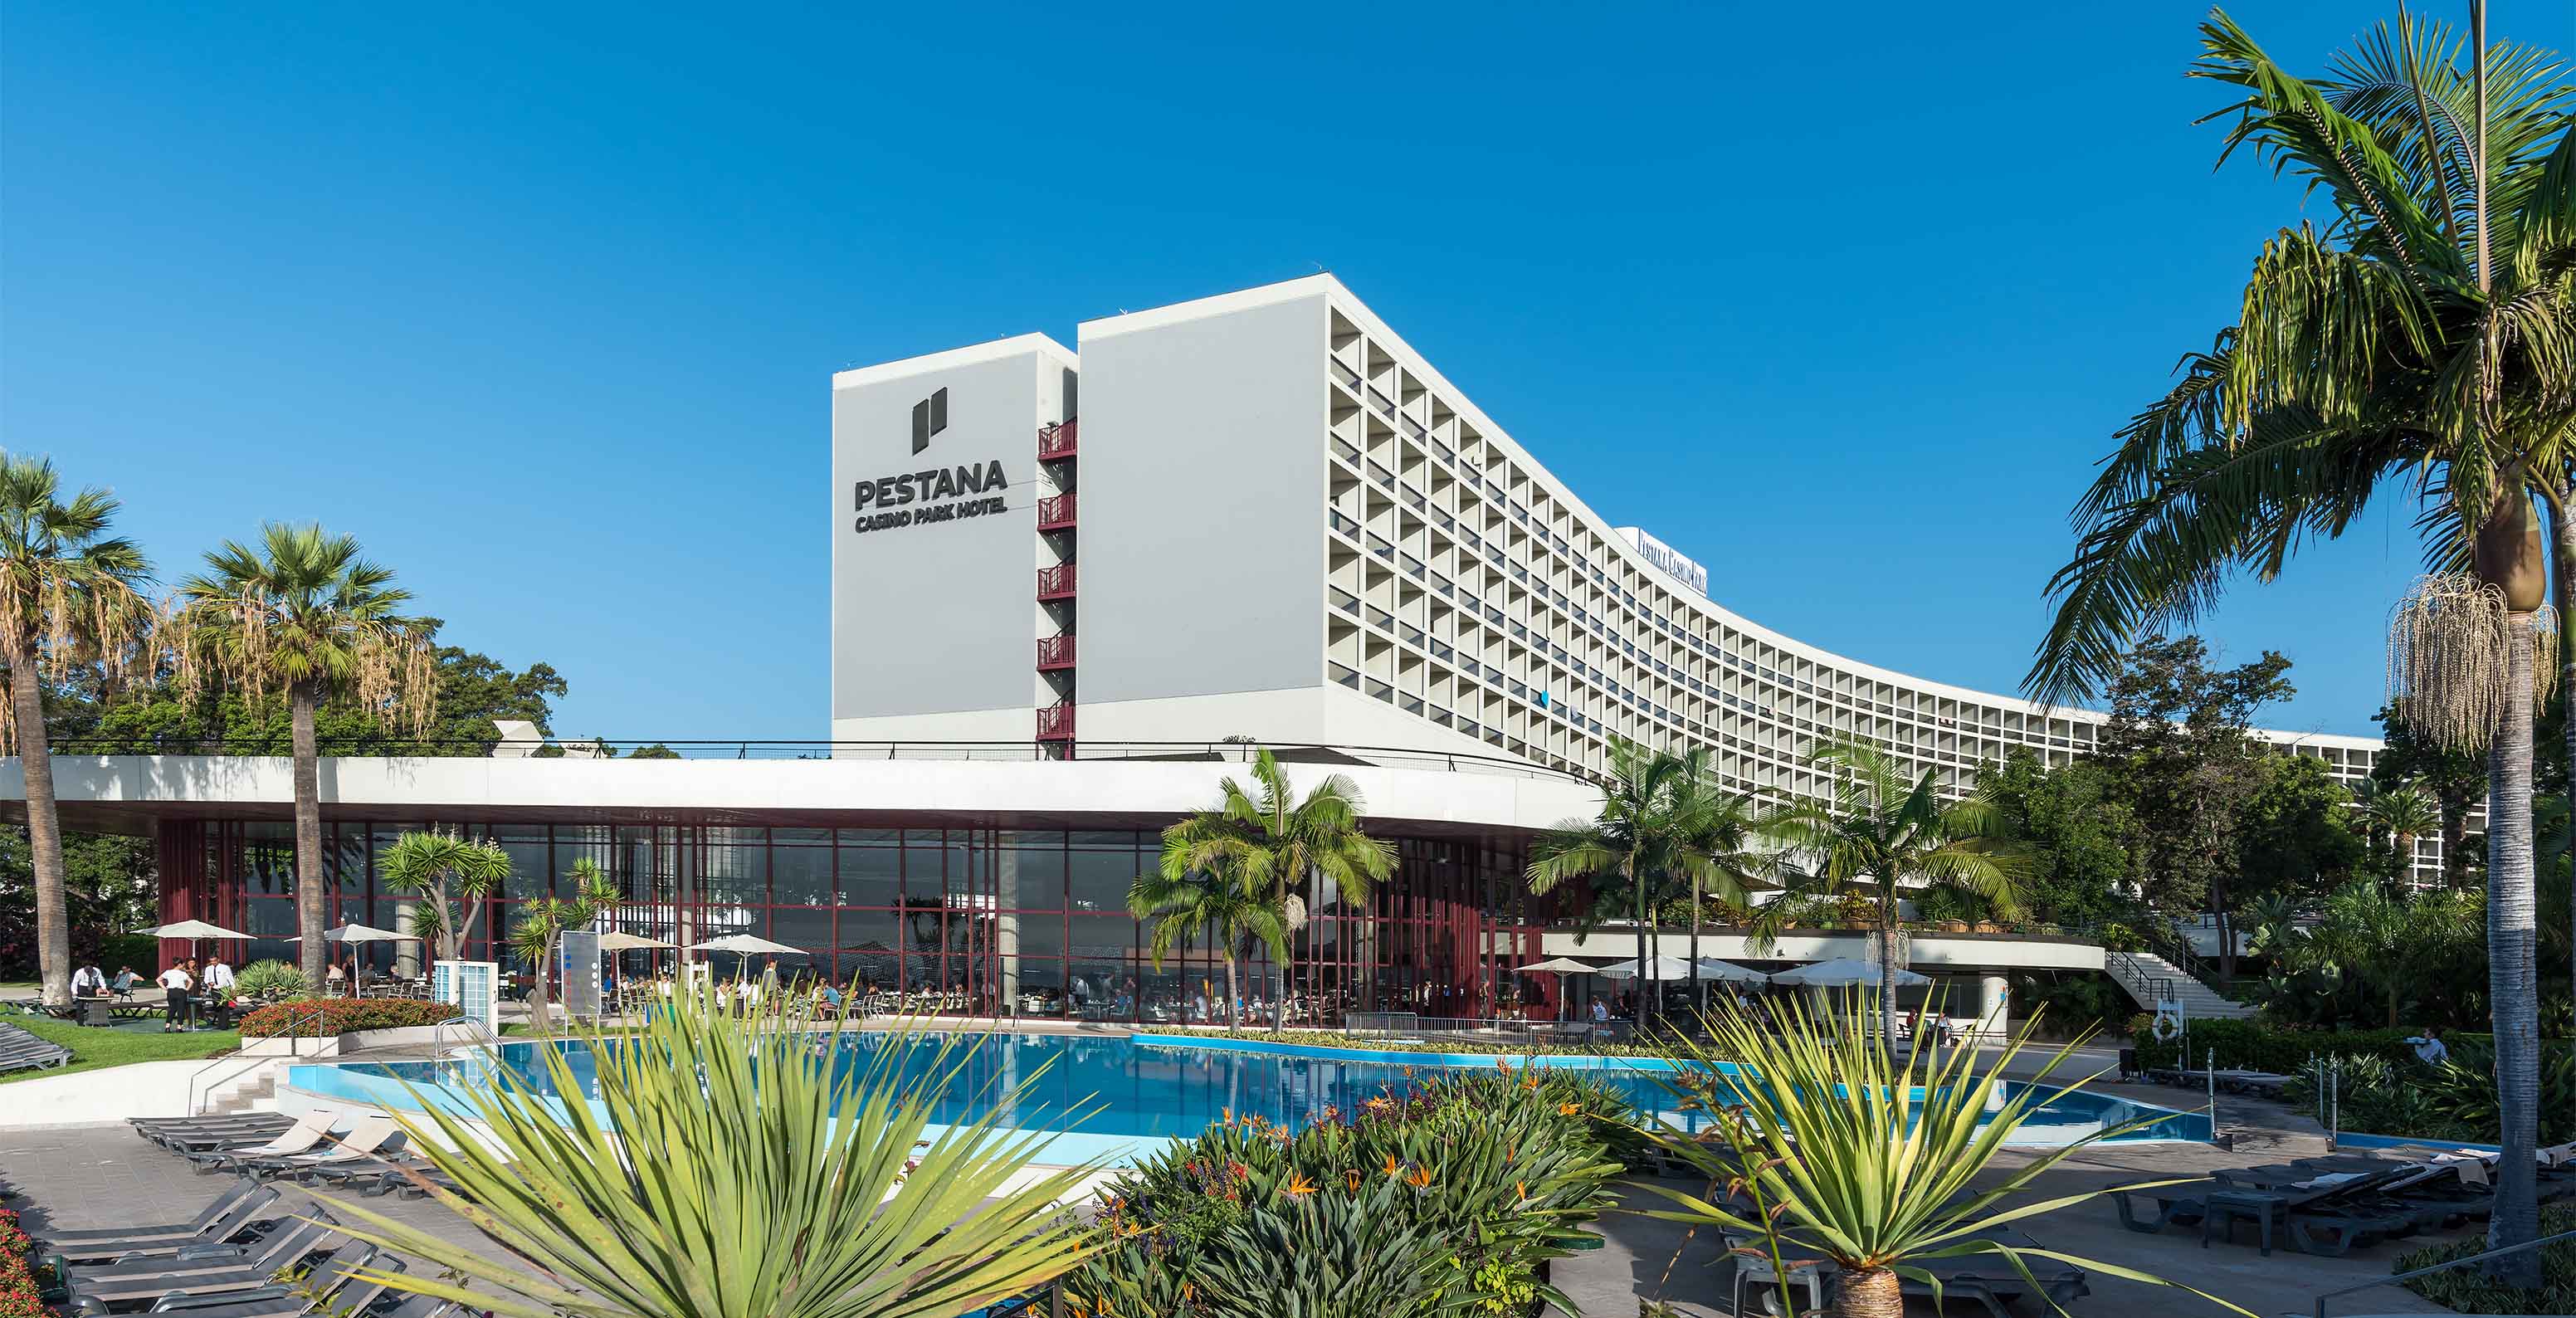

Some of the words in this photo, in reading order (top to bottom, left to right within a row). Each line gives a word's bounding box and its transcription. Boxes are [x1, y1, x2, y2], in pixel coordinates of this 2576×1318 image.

[855, 460, 1008, 511] PESTANA
[856, 510, 911, 533] CASINO
[914, 503, 955, 525] PARK
[956, 496, 1007, 520] HOTEL
